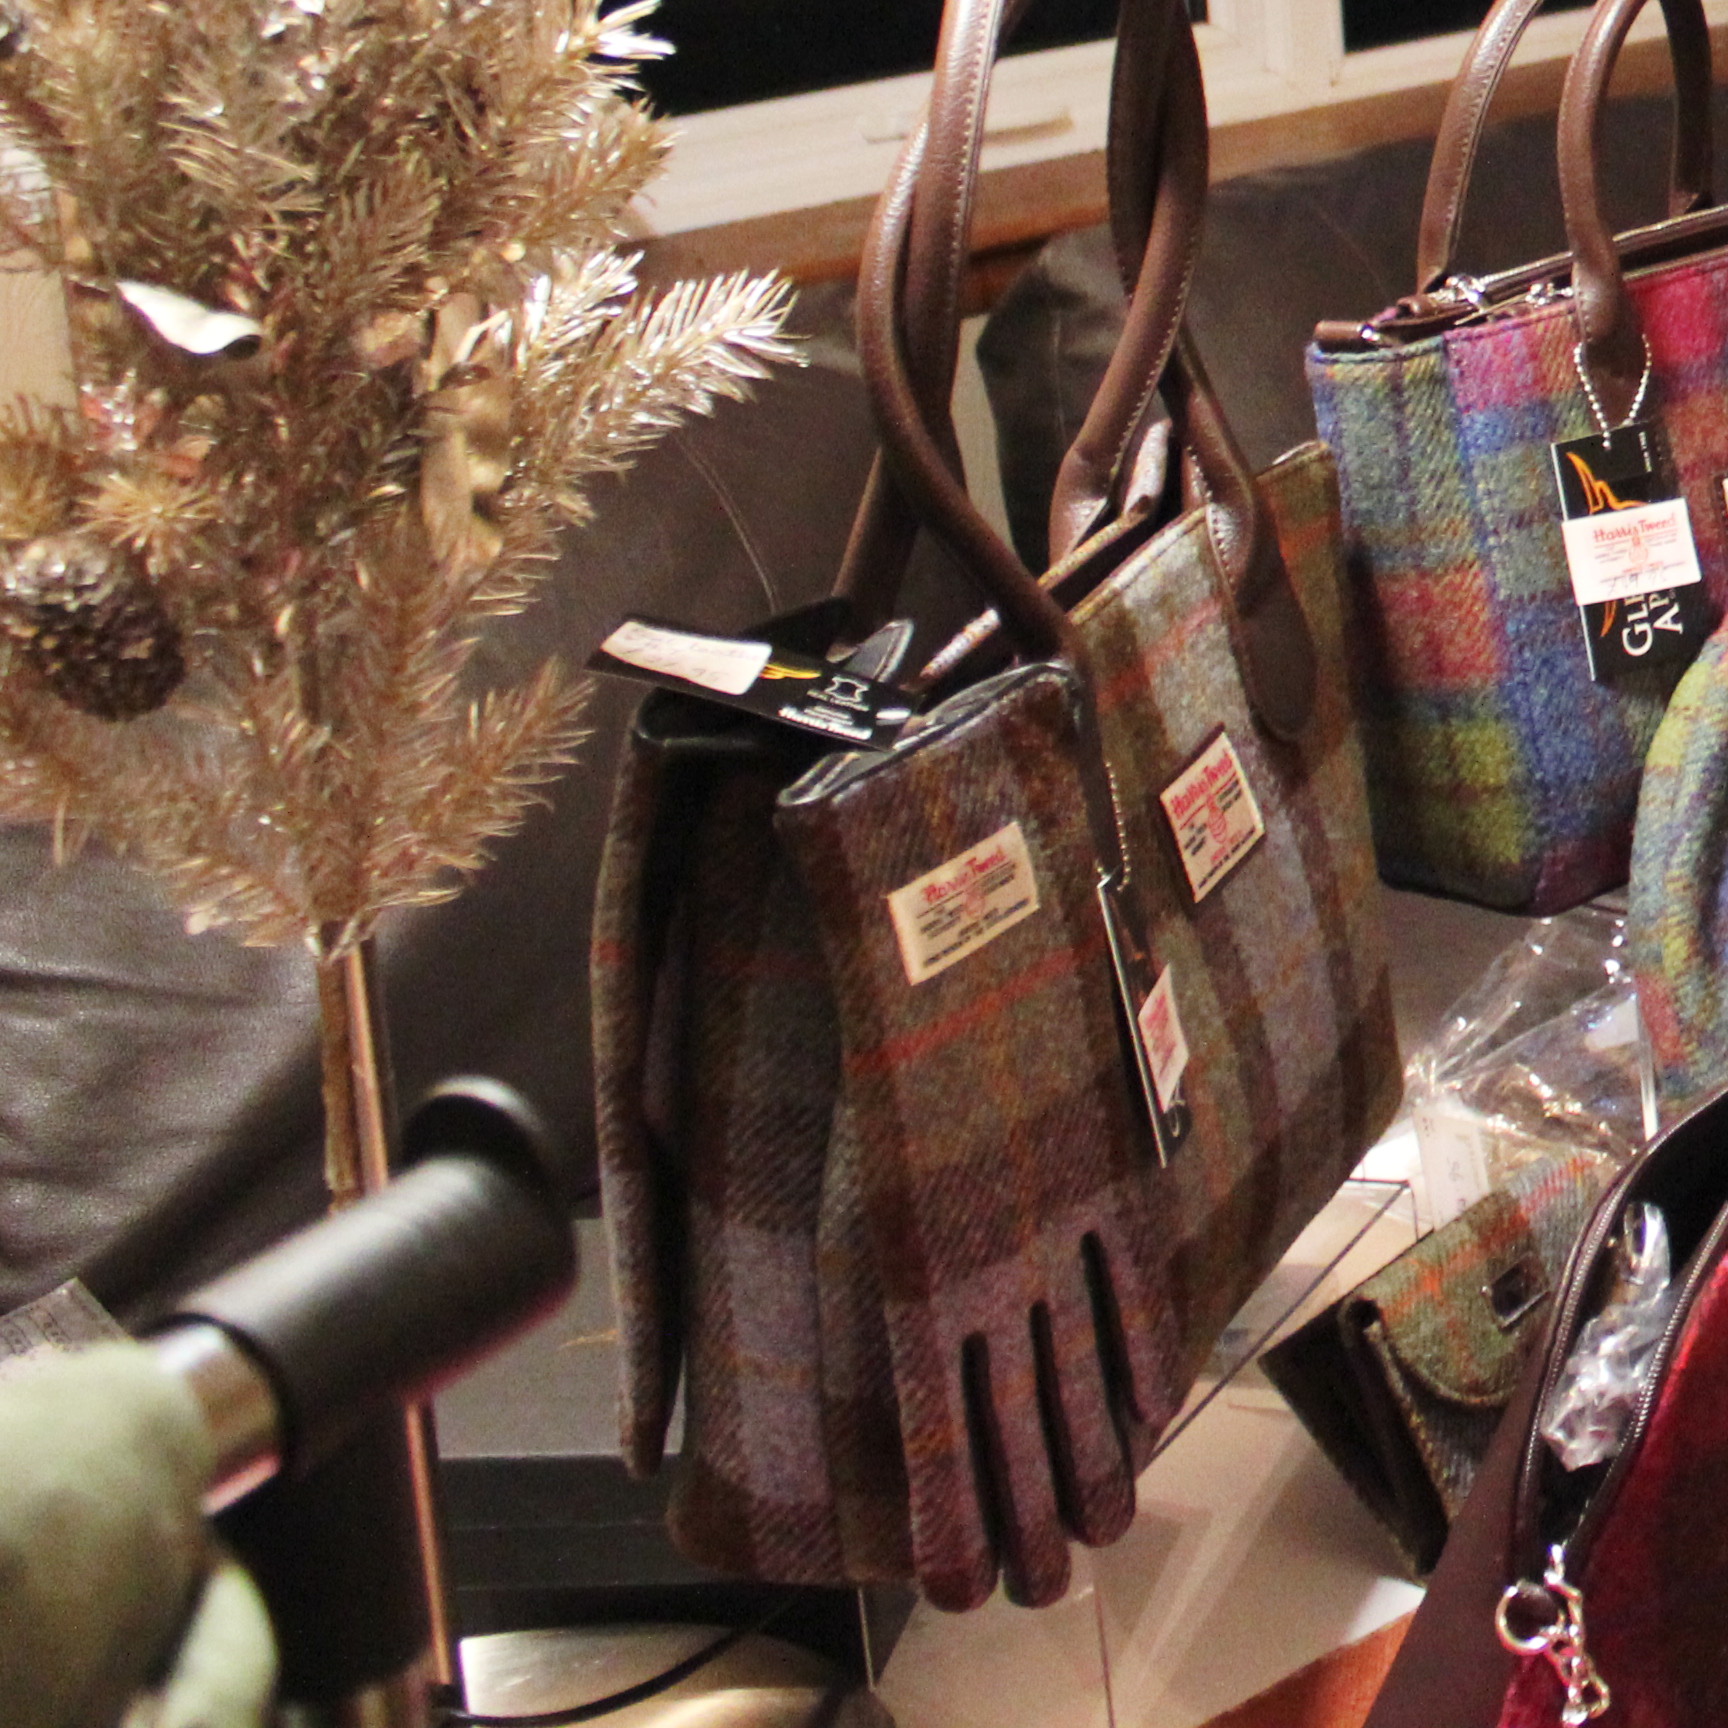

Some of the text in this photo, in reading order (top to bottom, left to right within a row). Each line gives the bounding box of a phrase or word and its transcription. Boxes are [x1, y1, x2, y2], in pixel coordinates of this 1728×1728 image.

[1593, 512, 1677, 543] Harris Tweed
[922, 844, 1006, 903] Harris Tweed
